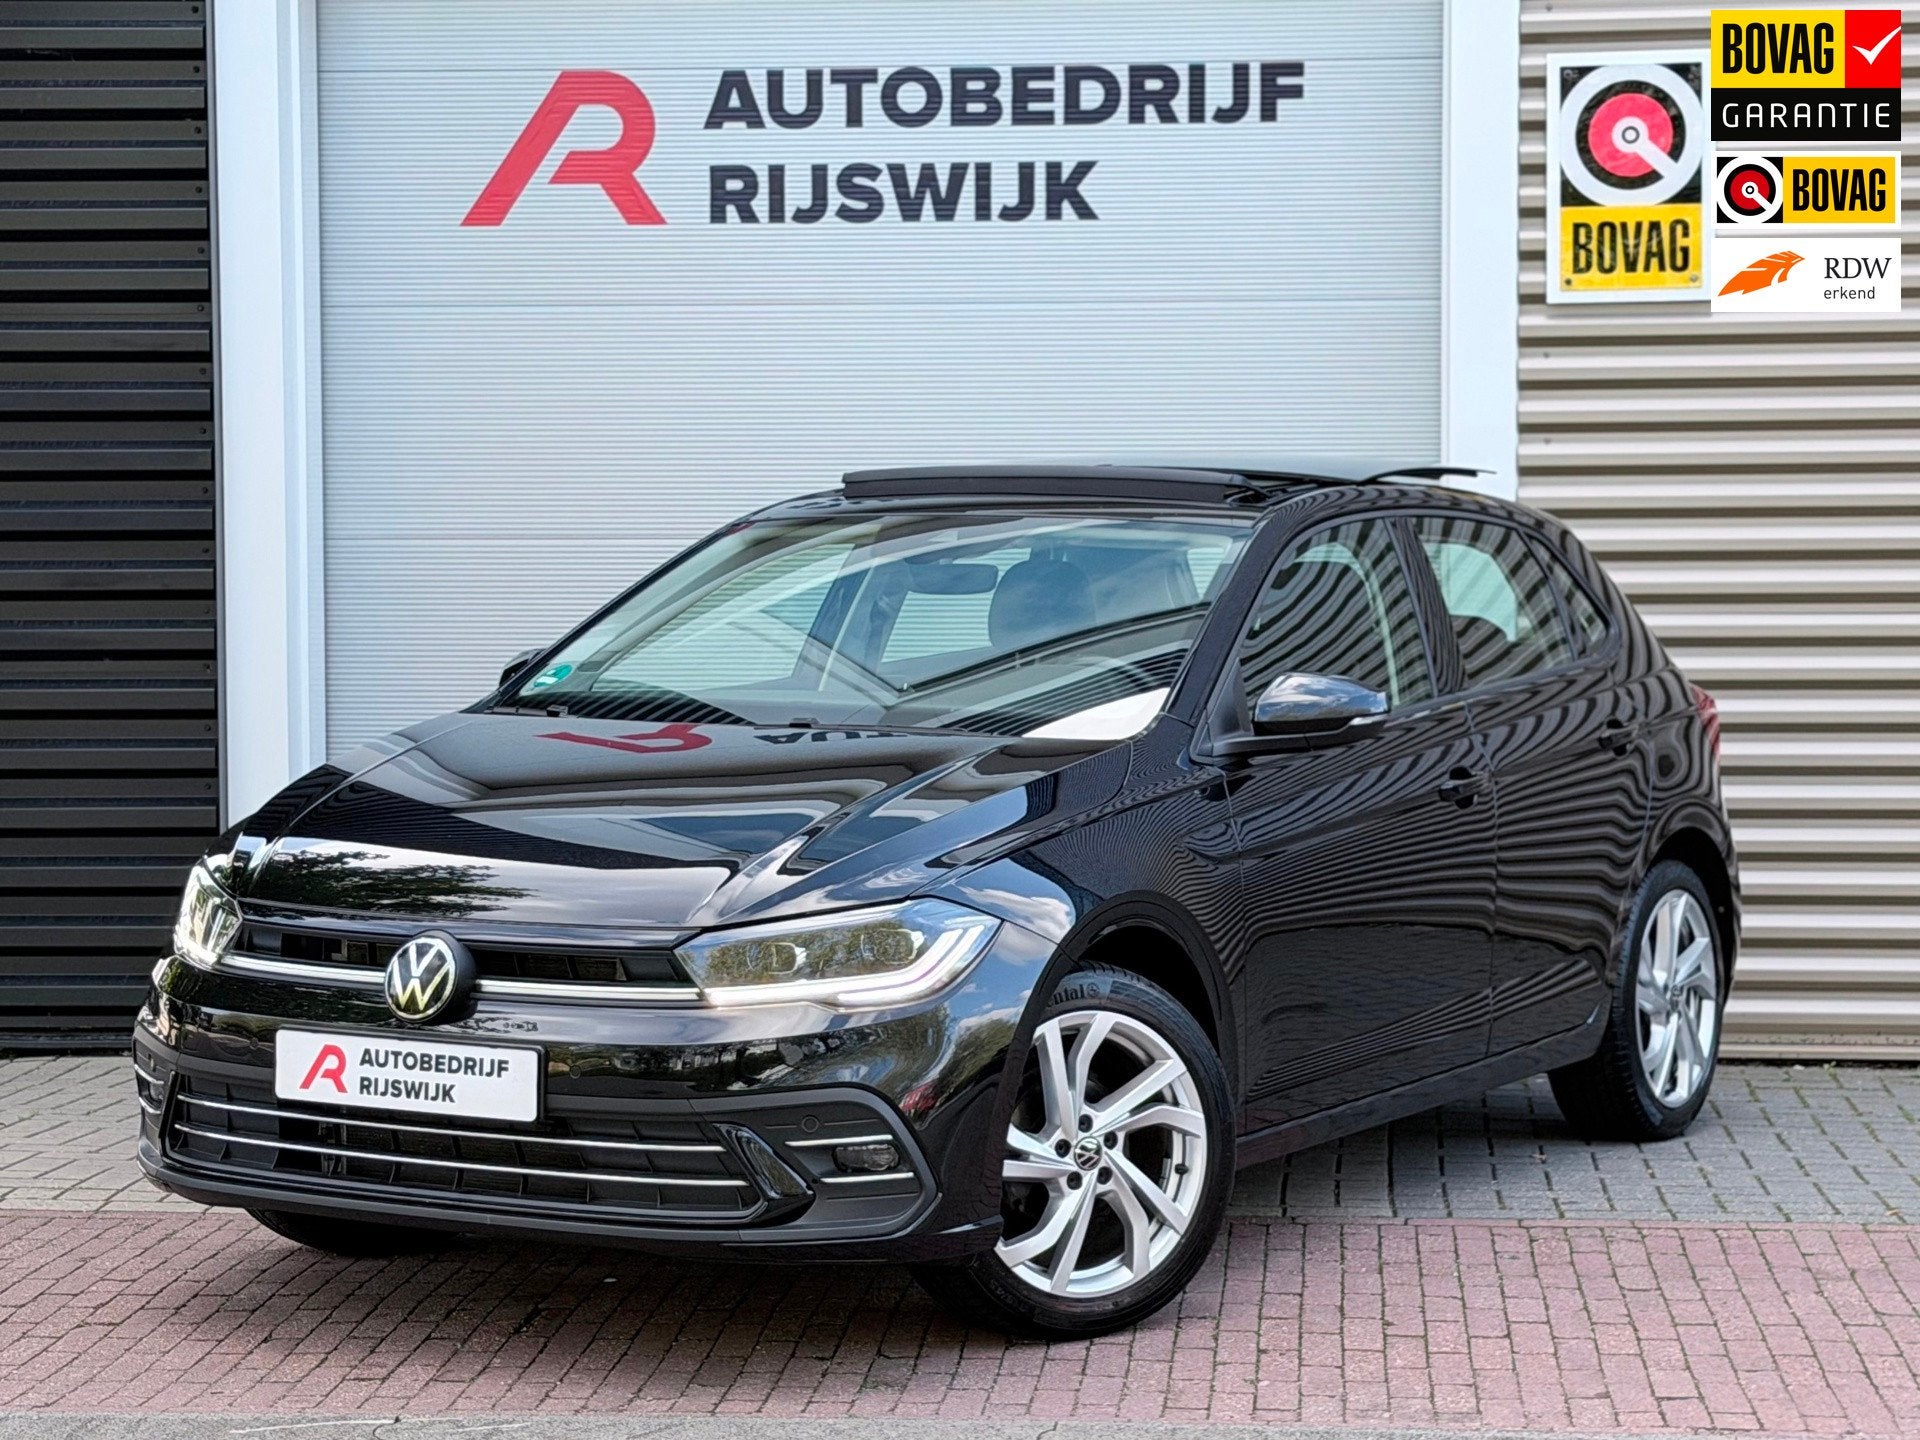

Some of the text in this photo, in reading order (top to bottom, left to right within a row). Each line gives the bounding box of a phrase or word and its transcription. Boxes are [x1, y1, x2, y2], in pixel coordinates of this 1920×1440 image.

[704, 62, 1305, 130] AUTOBEDRIJF
[709, 160, 1098, 224] RIJSWIJK
[1572, 218, 1690, 275] BOVAG
[359, 1047, 510, 1078] AUTOBEDRIJF
[359, 1076, 456, 1103] RIJSWIJK
